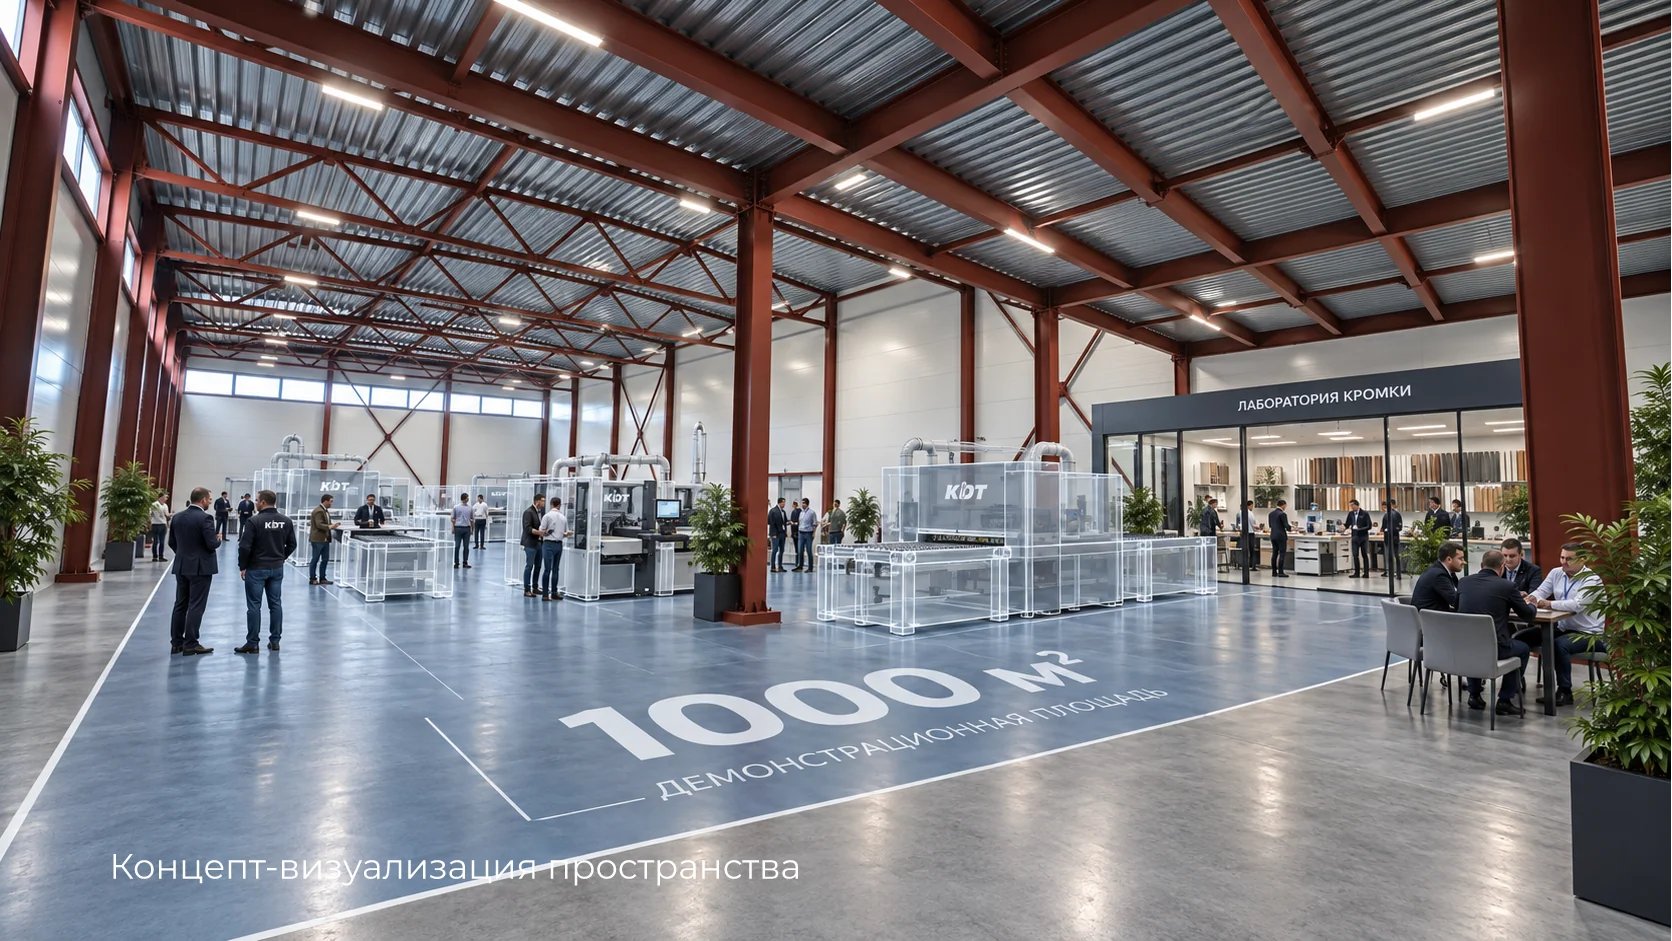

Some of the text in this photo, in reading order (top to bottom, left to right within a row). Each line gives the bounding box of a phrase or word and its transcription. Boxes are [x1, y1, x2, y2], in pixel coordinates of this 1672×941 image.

[1237, 384, 1412, 412] ЛАБОРАТОРИЯ КРОМКИ
[944, 481, 988, 500] KDT
[558, 667, 981, 761] 1000
[655, 687, 1169, 802] ДЕМОНСТРАЦИОННАЯ ПЛОЩАДЬ
